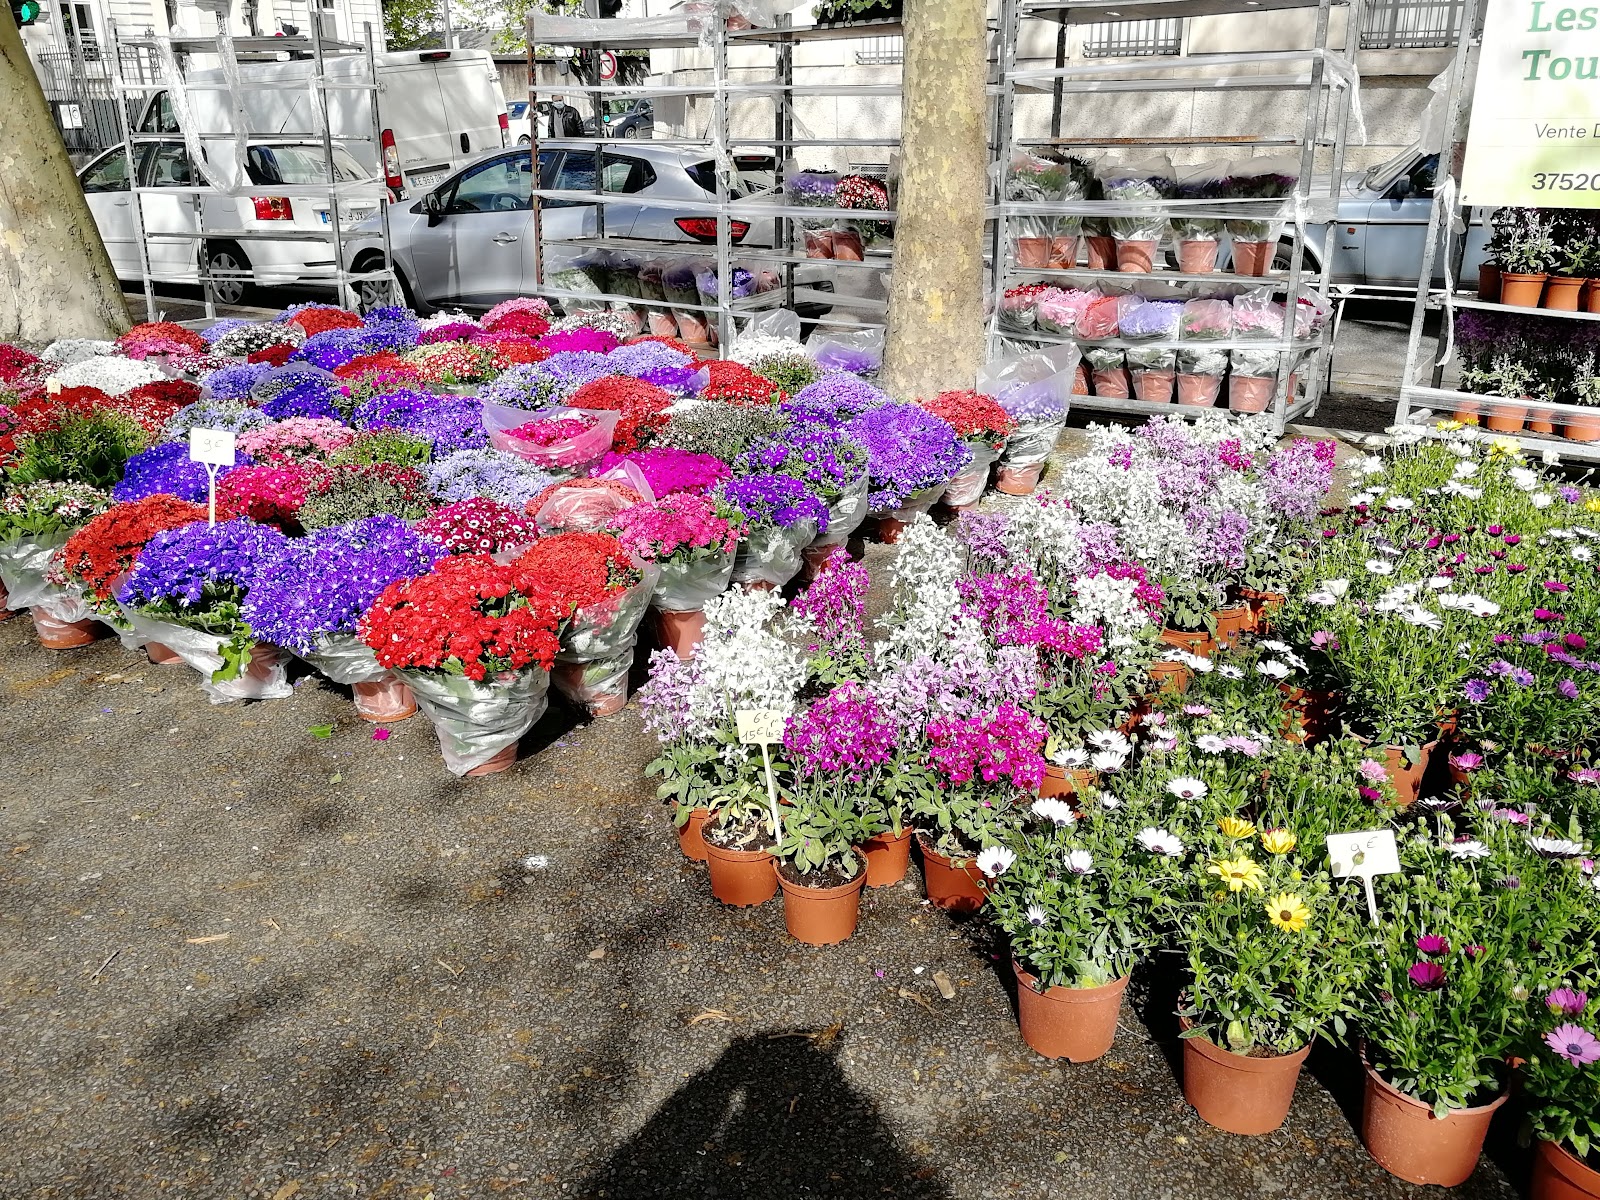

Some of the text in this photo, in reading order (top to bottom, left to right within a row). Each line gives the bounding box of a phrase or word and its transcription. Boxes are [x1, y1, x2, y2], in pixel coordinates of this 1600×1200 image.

[1526, 1, 1599, 32] Les
[1534, 123, 1587, 139] Vente
[1531, 172, 1600, 191] 37520
